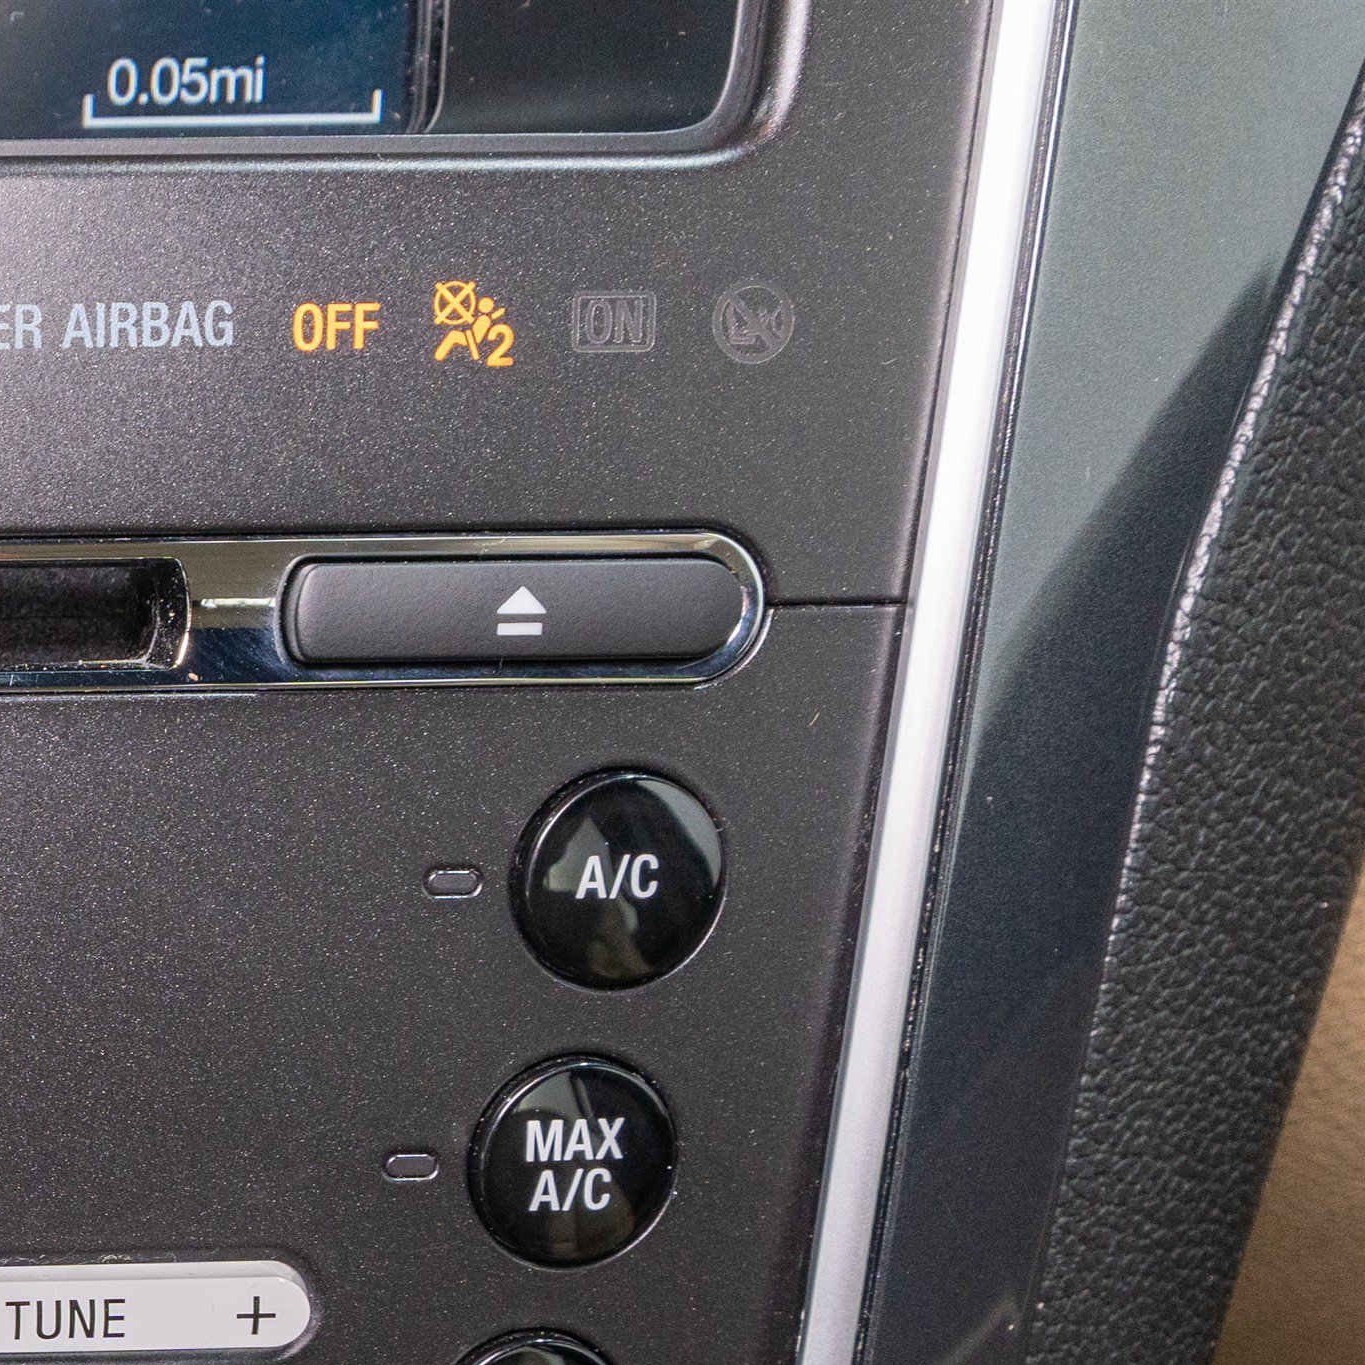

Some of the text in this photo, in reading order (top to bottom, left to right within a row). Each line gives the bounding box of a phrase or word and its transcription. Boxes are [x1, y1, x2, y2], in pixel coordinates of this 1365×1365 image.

[106, 55, 267, 106] 0.05mi
[61, 300, 235, 349] AIRBAG
[292, 302, 381, 352] OFF
[575, 854, 659, 900] A/C
[525, 1117, 625, 1162] MAX
[528, 1168, 612, 1212] A/C
[6, 1299, 126, 1340] TUNE
